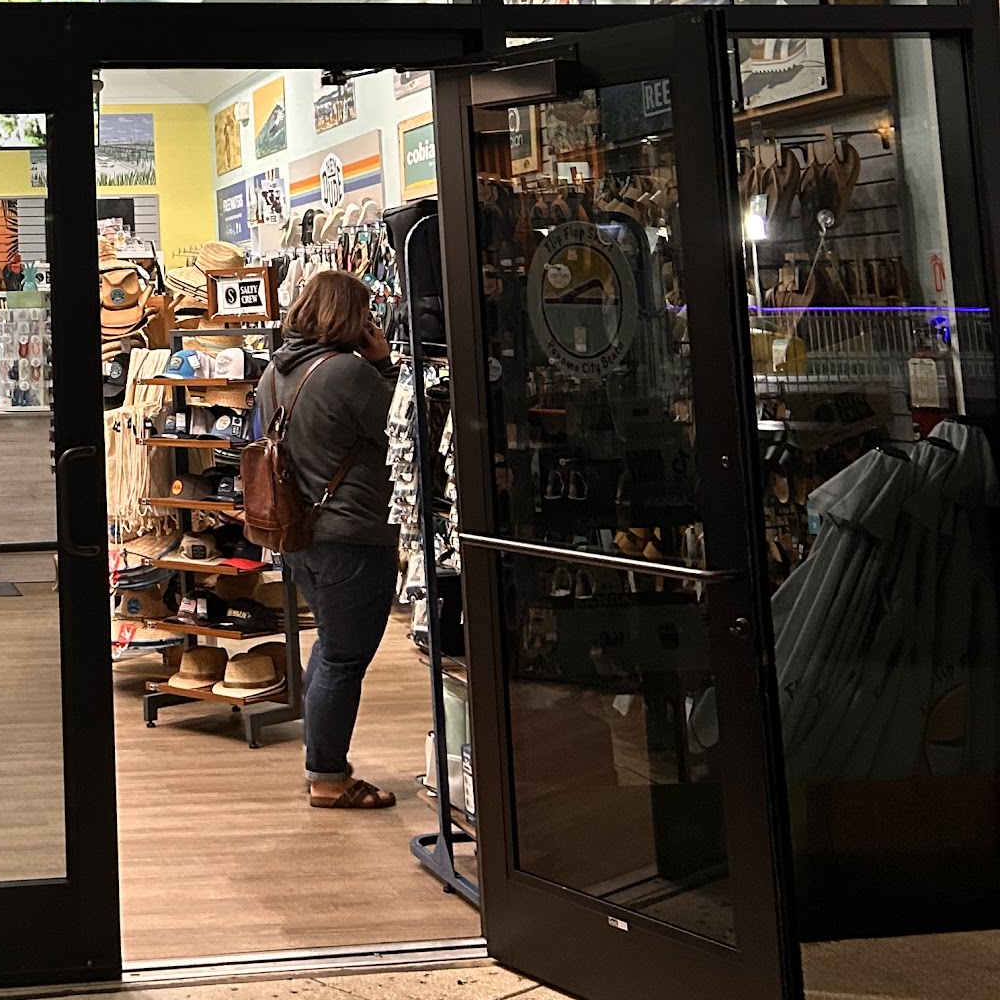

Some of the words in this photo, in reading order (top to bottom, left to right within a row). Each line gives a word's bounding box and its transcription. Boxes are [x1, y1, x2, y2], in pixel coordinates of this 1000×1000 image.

[644, 79, 672, 109] REE
[240, 285, 258, 294] SALTY
[240, 294, 258, 304] CREW
